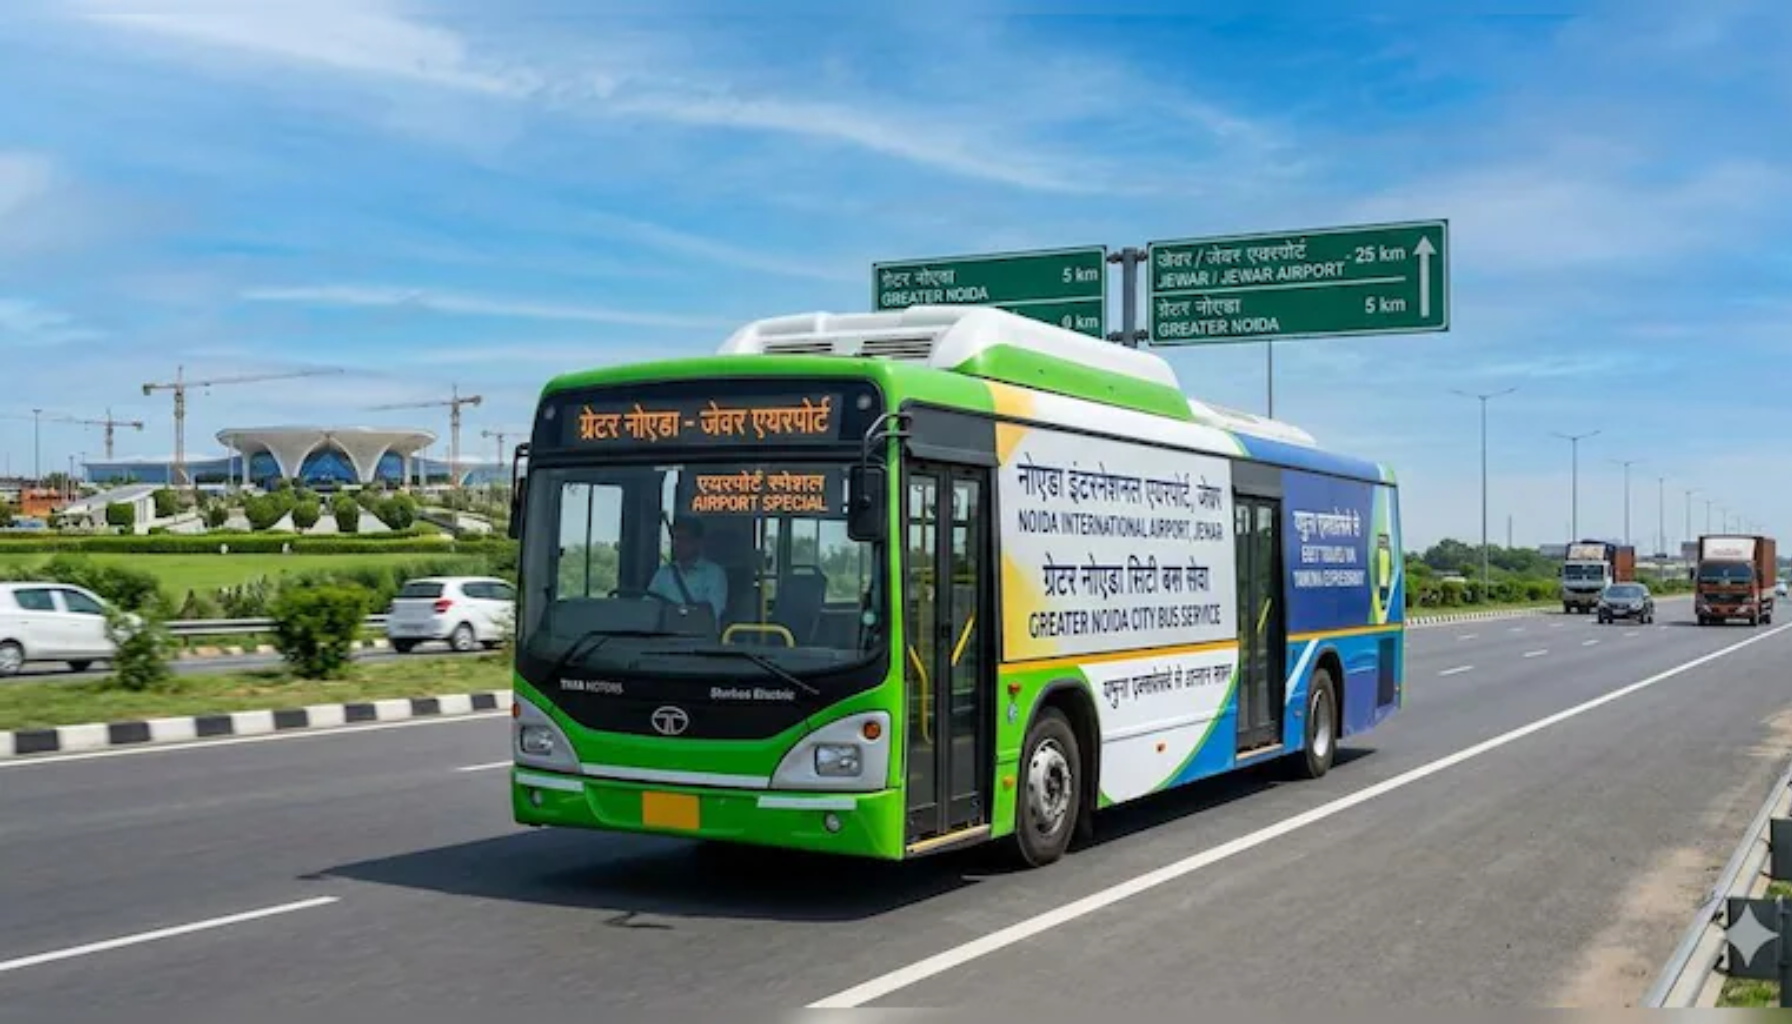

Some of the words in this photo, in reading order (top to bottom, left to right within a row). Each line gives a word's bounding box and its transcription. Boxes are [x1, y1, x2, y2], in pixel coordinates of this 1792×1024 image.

[1355, 246, 1376, 264] 25
[1379, 245, 1406, 262] km
[1062, 268, 1072, 283] 5
[1075, 266, 1099, 282] km
[1157, 270, 1209, 289] JEWAR
[1221, 267, 1273, 285] JEWAR
[1276, 260, 1345, 281] AIRPORT
[881, 289, 943, 307] GREATER
[946, 286, 989, 303] NOIDA
[1365, 296, 1376, 314] 5
[1379, 296, 1406, 313] km
[1075, 314, 1099, 329] km
[1158, 318, 1228, 338] GREATER
[1232, 316, 1279, 333] NOIDA
[579, 405, 621, 439] ग्रेटर
[624, 403, 680, 442] नोएडा
[700, 401, 747, 434] जेवर
[750, 396, 831, 438] एयरपोर्ट
[696, 469, 763, 494] एयरपोर्ट
[1016, 451, 1064, 502] नोएडा
[692, 494, 758, 512] AIRPORT
[762, 494, 829, 512] SPECIAL
[1018, 508, 1059, 534] NOIDA
[1061, 512, 1148, 538] INTERNATIONAL
[1042, 551, 1077, 596] ग्रेटर
[1080, 552, 1124, 601] नोएडा
[1127, 554, 1158, 595] सिटी
[1161, 565, 1183, 594] बस
[1186, 555, 1210, 593] सेवा
[1028, 610, 1089, 639] GREATER
[1092, 607, 1131, 634] NOIDA
[1131, 606, 1157, 631] CITY
[1158, 606, 1180, 629] BUS
[1181, 604, 1221, 628] SERVICE
